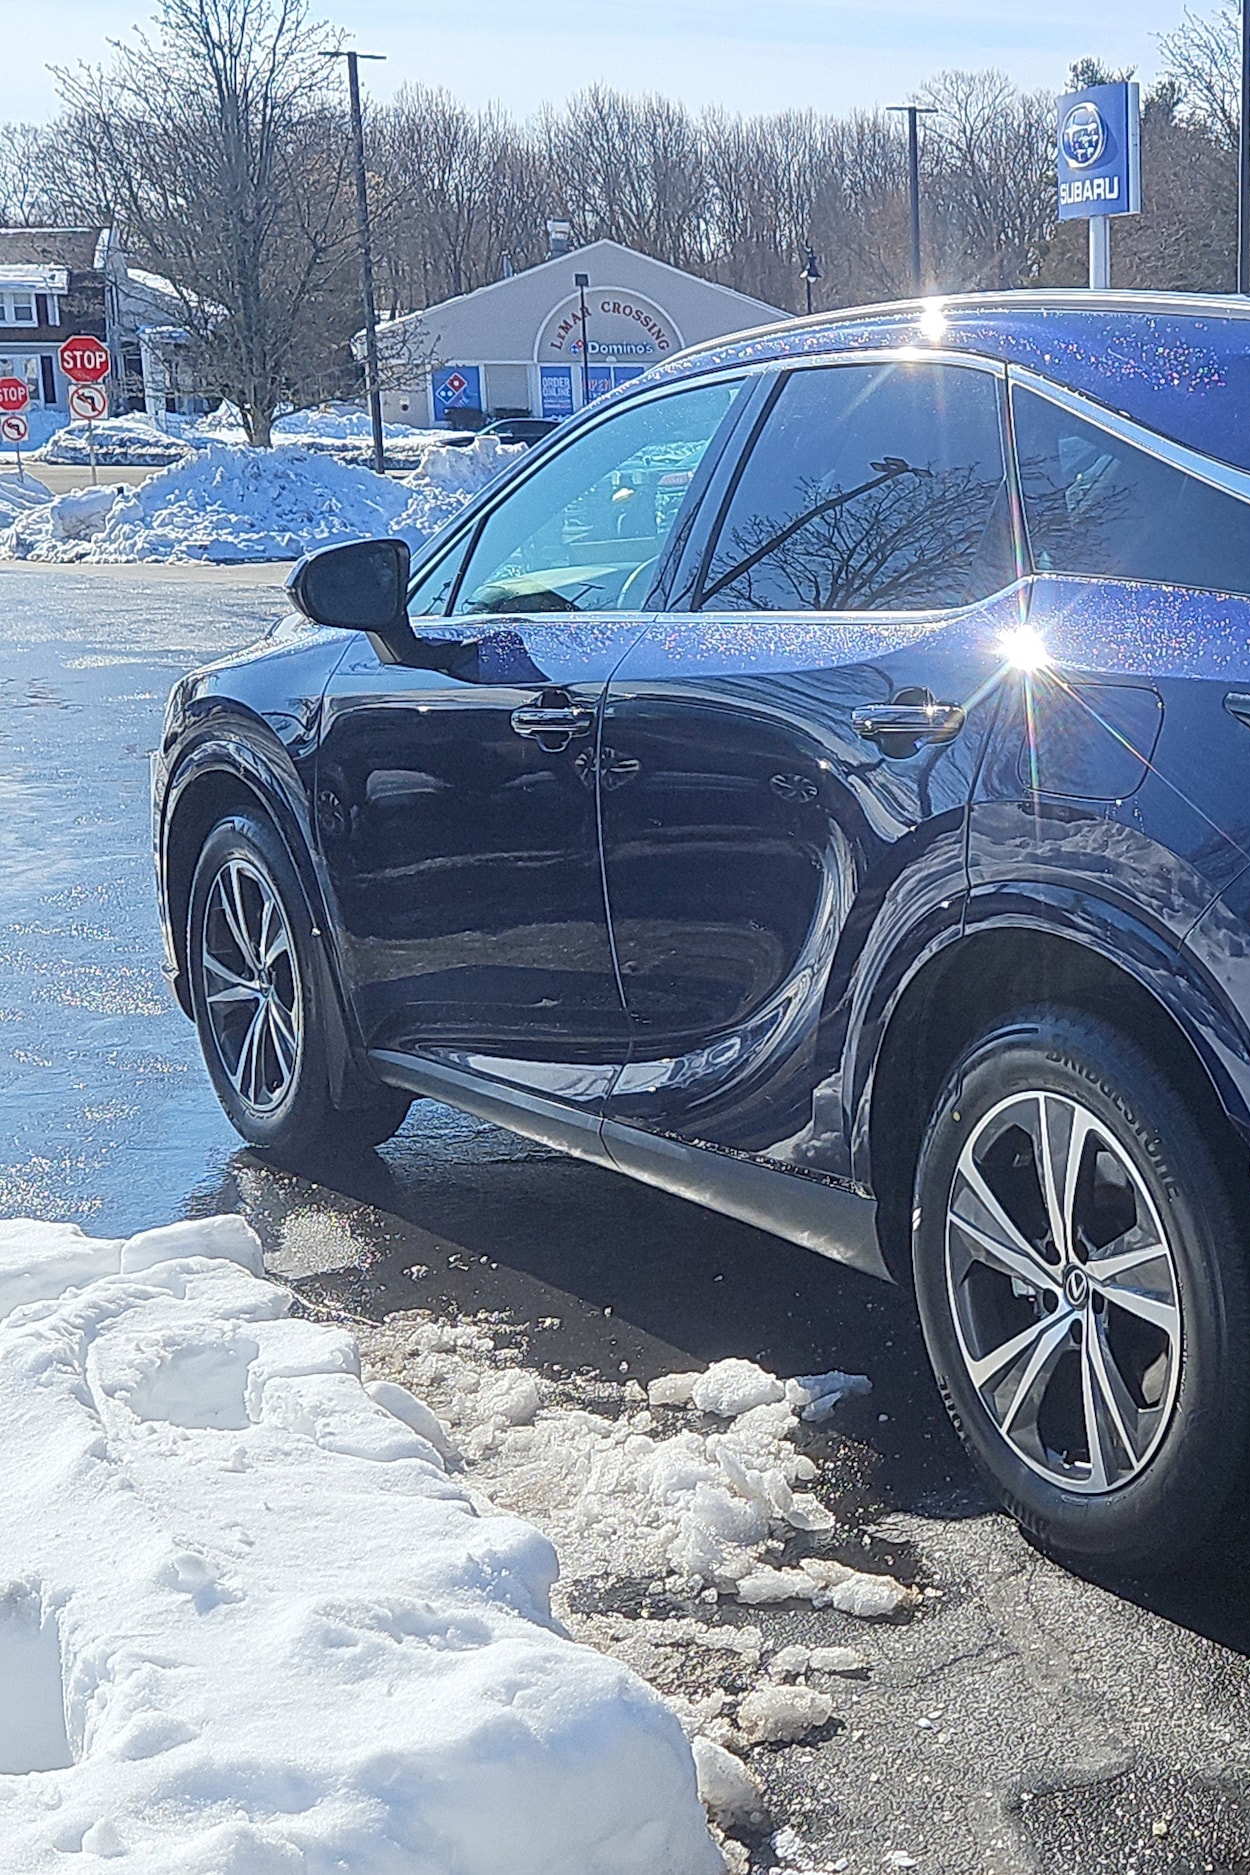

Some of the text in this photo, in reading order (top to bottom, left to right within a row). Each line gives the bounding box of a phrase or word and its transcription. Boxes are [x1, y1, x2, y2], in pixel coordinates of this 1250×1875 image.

[1060, 176, 1119, 205] SUBARU
[600, 301, 670, 351] CROSSING
[588, 341, 654, 354] Domino's
[63, 350, 107, 369] STOP
[542, 377, 570, 387] ORDER
[543, 387, 571, 397] ONLINE
